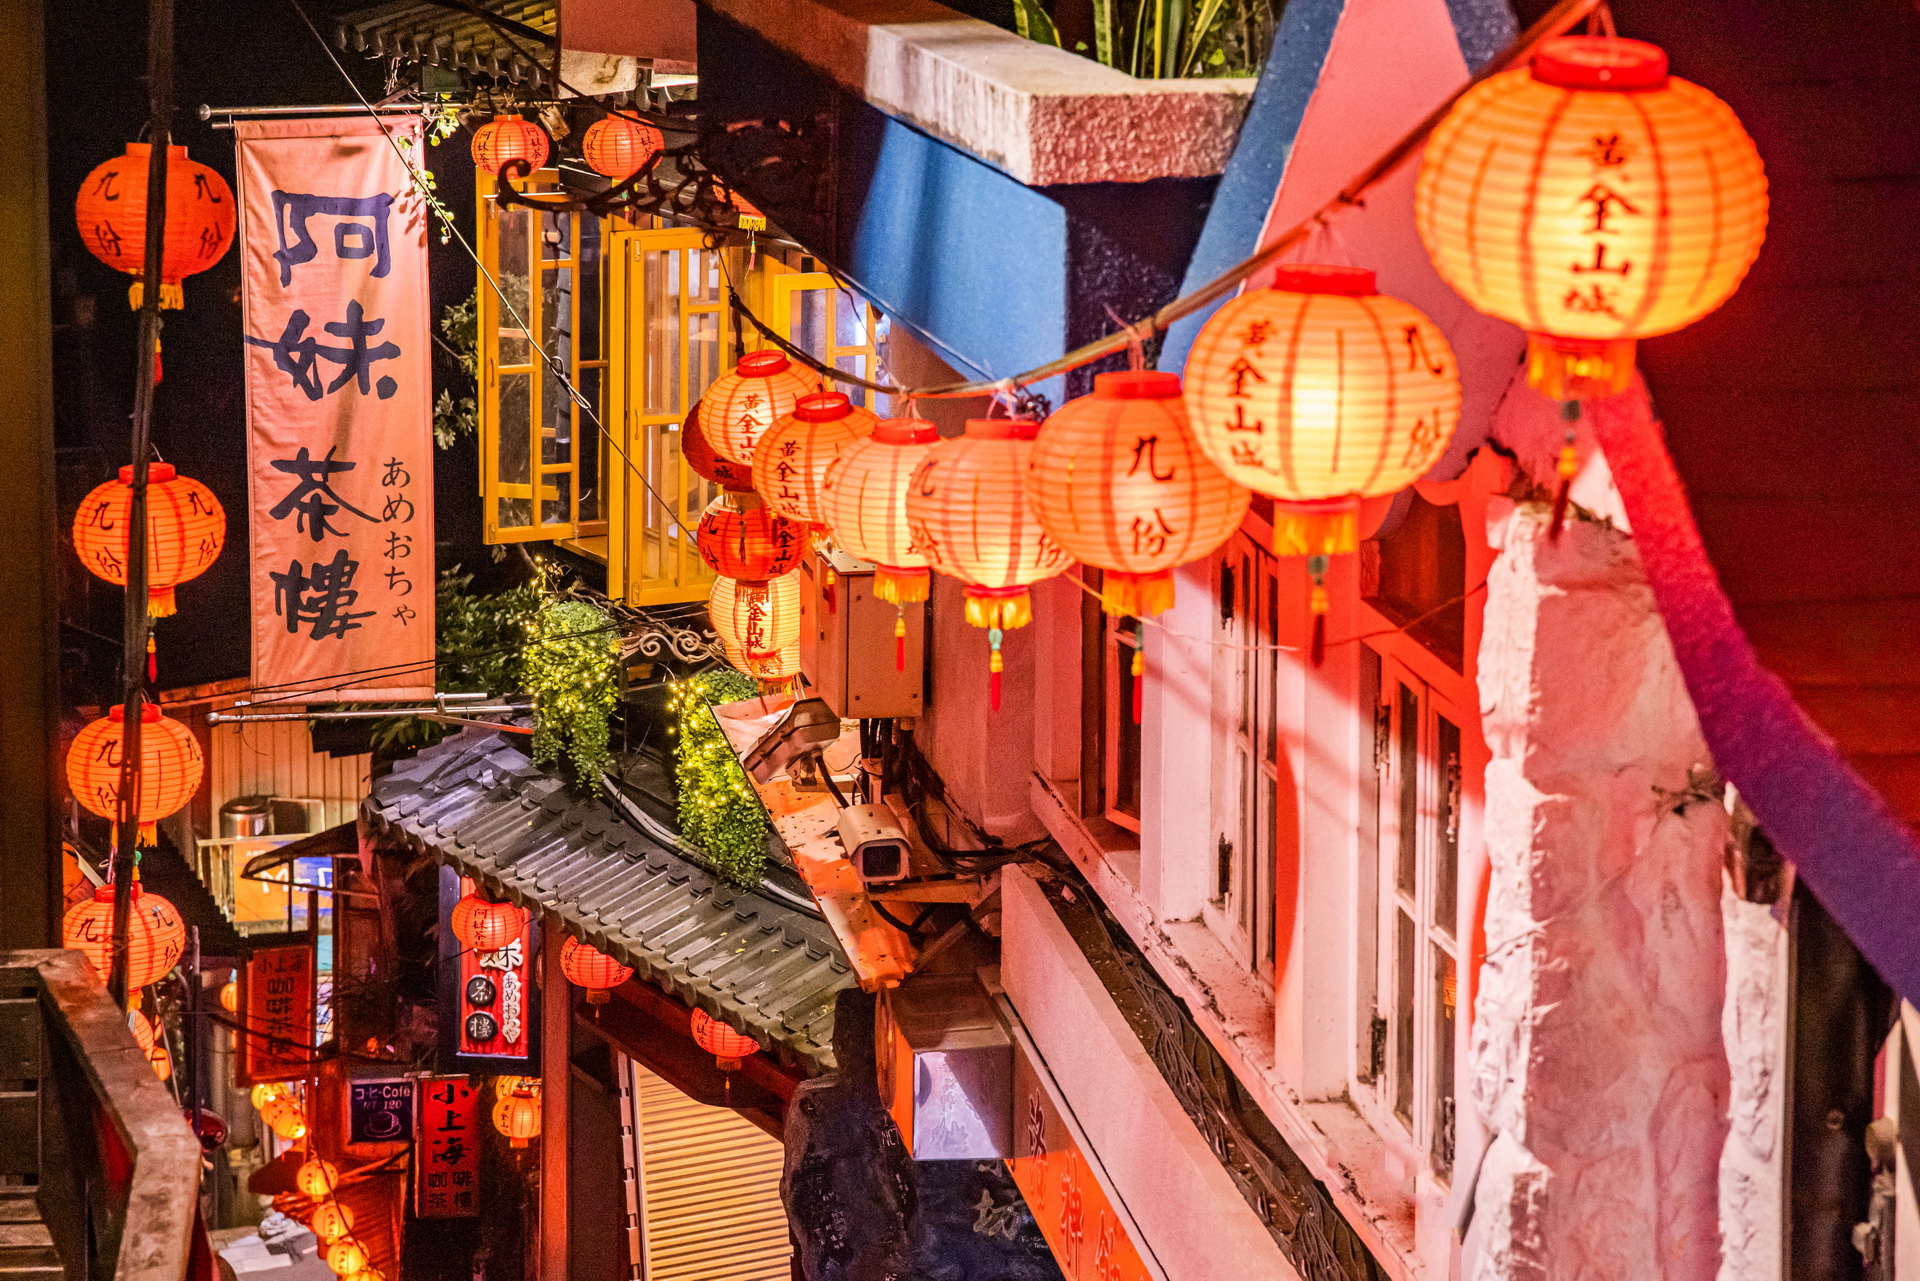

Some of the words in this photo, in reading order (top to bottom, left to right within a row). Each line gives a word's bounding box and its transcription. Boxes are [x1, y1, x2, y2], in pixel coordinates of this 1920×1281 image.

[92, 171, 122, 257] 九份
[194, 173, 223, 260] 九份
[244, 189, 402, 640] 阿妹茶樓
[1127, 434, 1176, 558] 九份
[89, 501, 122, 579] 九份
[432, 1083, 472, 1166] 小上海
